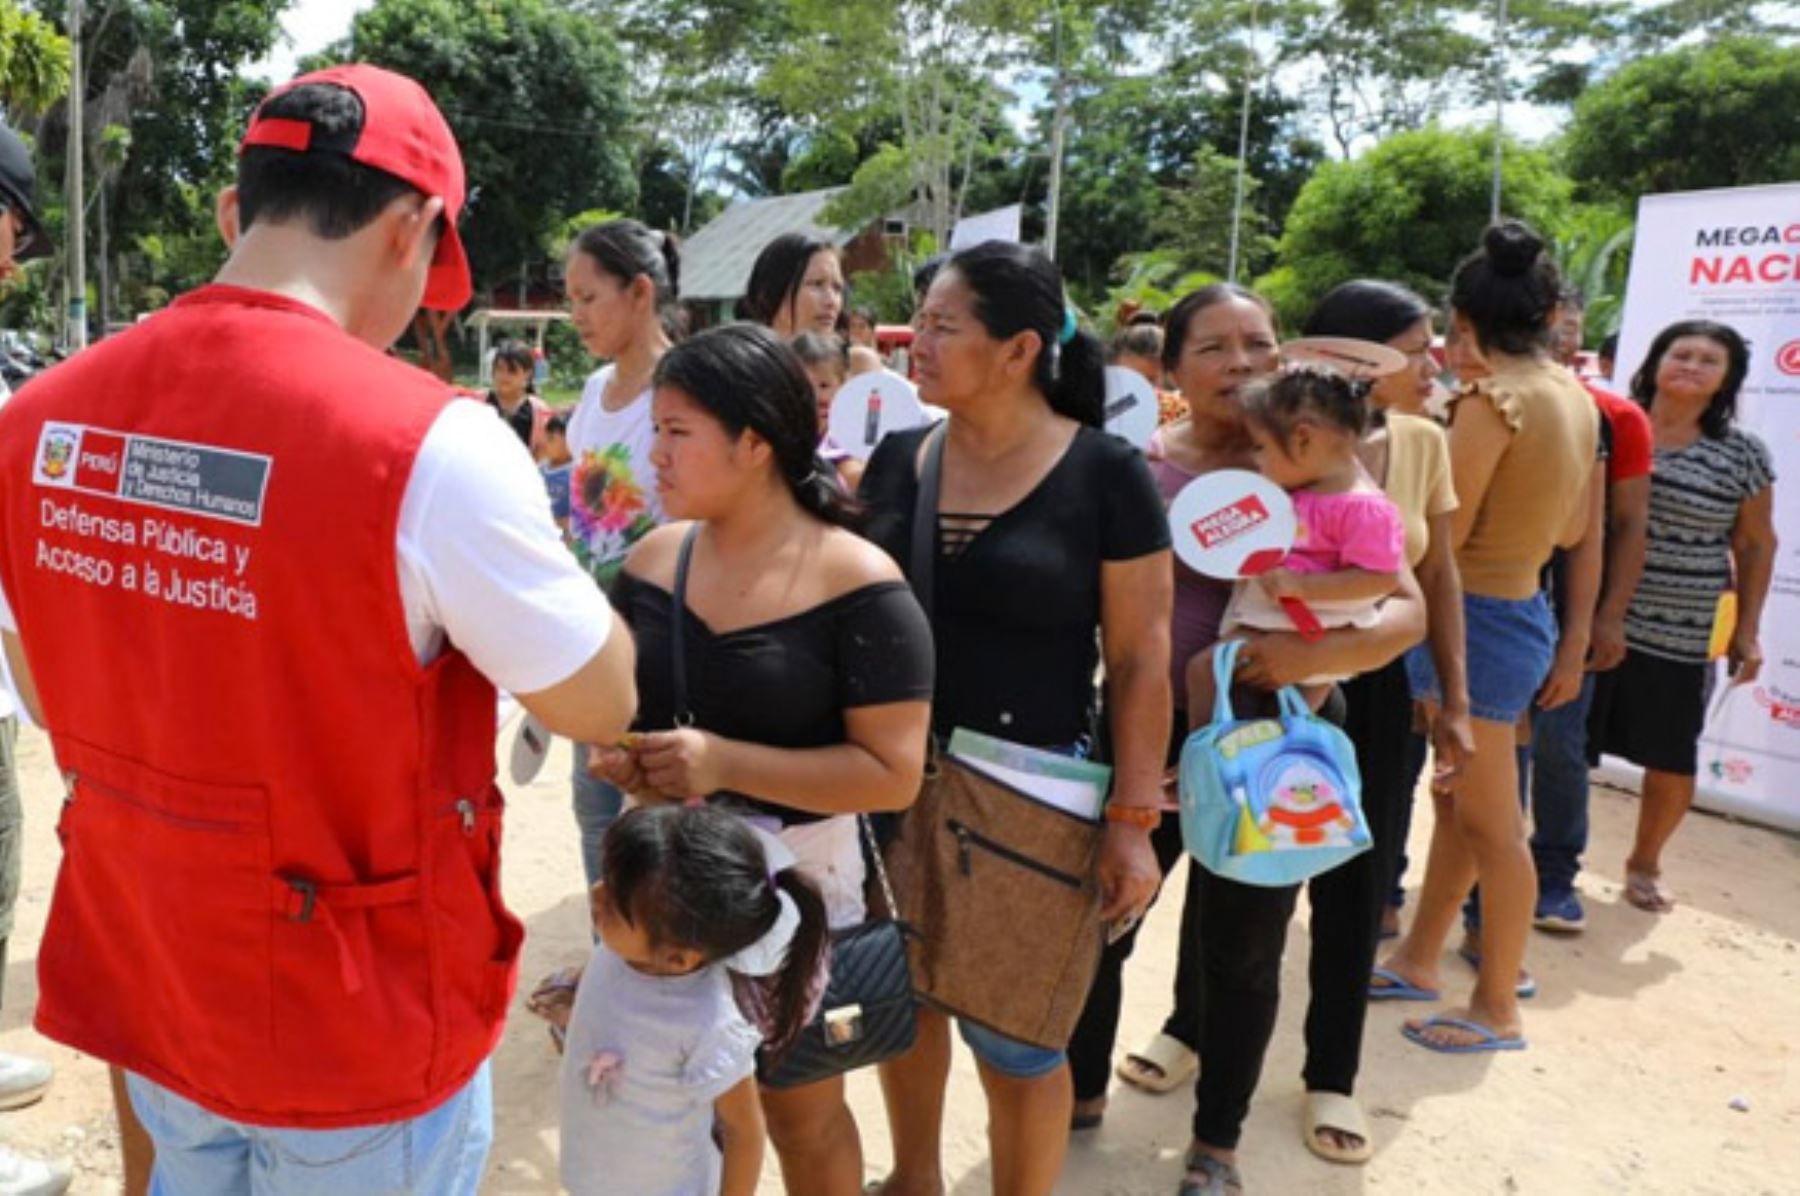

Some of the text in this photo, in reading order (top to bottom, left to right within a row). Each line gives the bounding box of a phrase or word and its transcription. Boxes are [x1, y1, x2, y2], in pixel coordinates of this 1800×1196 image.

[81, 451, 117, 473] PERÚ
[131, 442, 200, 467] Ministerio
[127, 464, 201, 487] de Justicia
[136, 482, 192, 505] Derechos
[196, 490, 255, 517] Humanos
[1197, 508, 1242, 534] MEGA
[41, 499, 250, 576] Defensa Pública y
[36, 541, 257, 619] Acceso a la Justicia
